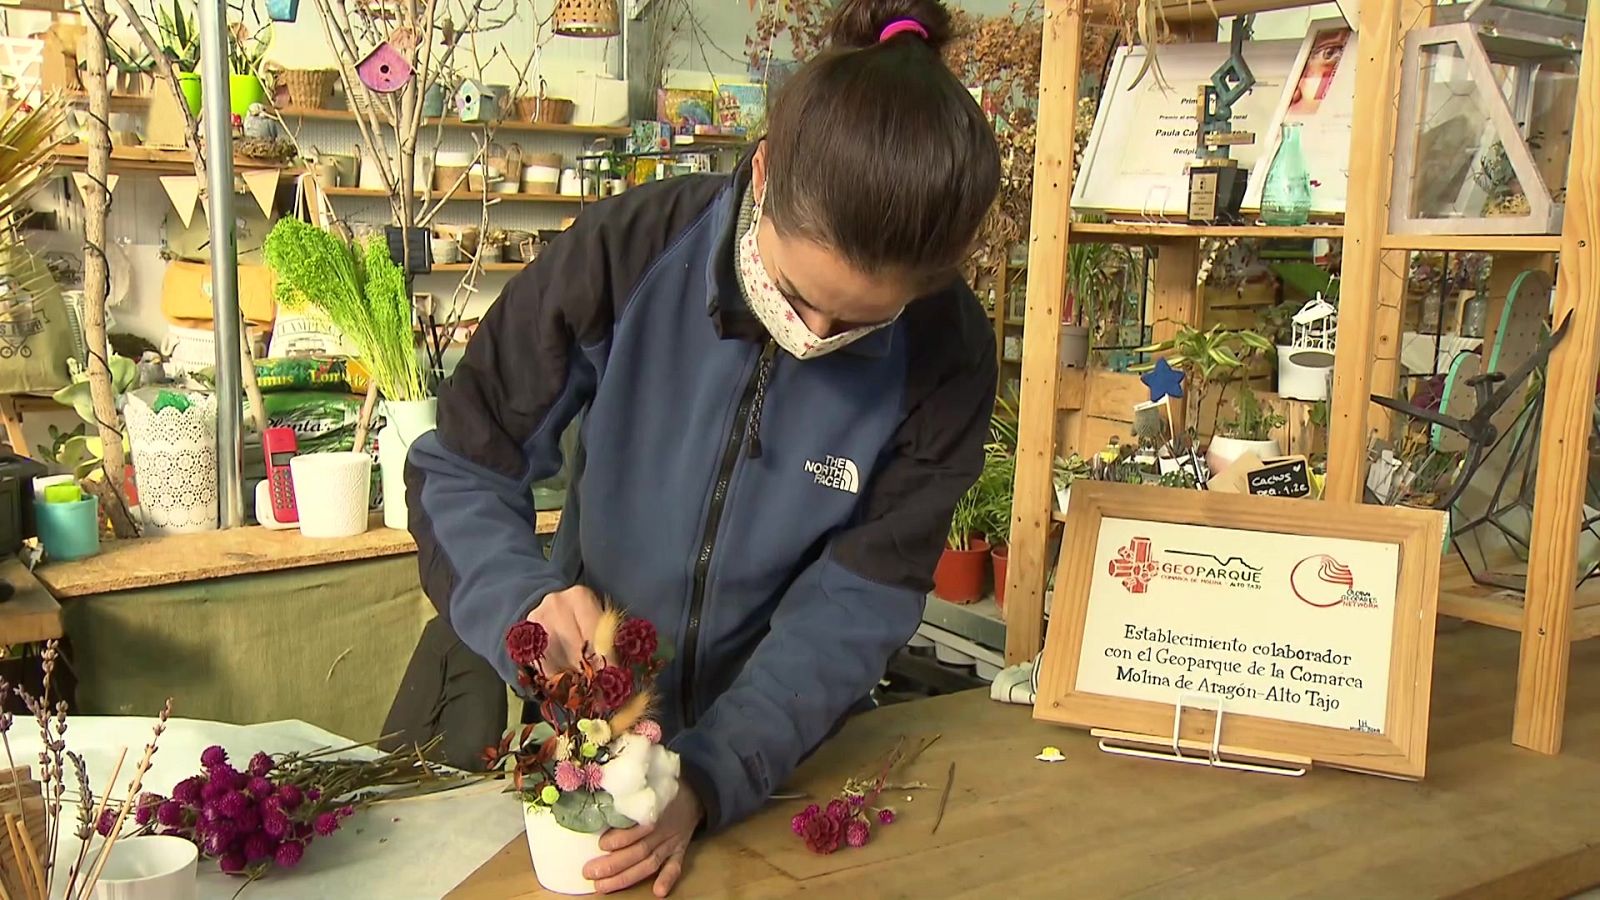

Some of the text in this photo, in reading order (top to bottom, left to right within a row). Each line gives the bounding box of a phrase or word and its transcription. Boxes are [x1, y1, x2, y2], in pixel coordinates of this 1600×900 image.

[1155, 128, 1181, 137] Paula
[804, 459, 844, 481] NORTH
[825, 455, 846, 469] THE
[813, 474, 841, 489] FACE
[1161, 562, 1263, 584] GEOPARQUE
[1123, 623, 1352, 665] Establecimiento colaborador
[1104, 646, 1363, 689] con el Geoparque de la Comarca
[1116, 665, 1171, 687] Molina
[1174, 674, 1193, 690] de
[1304, 689, 1340, 712] Tajo
